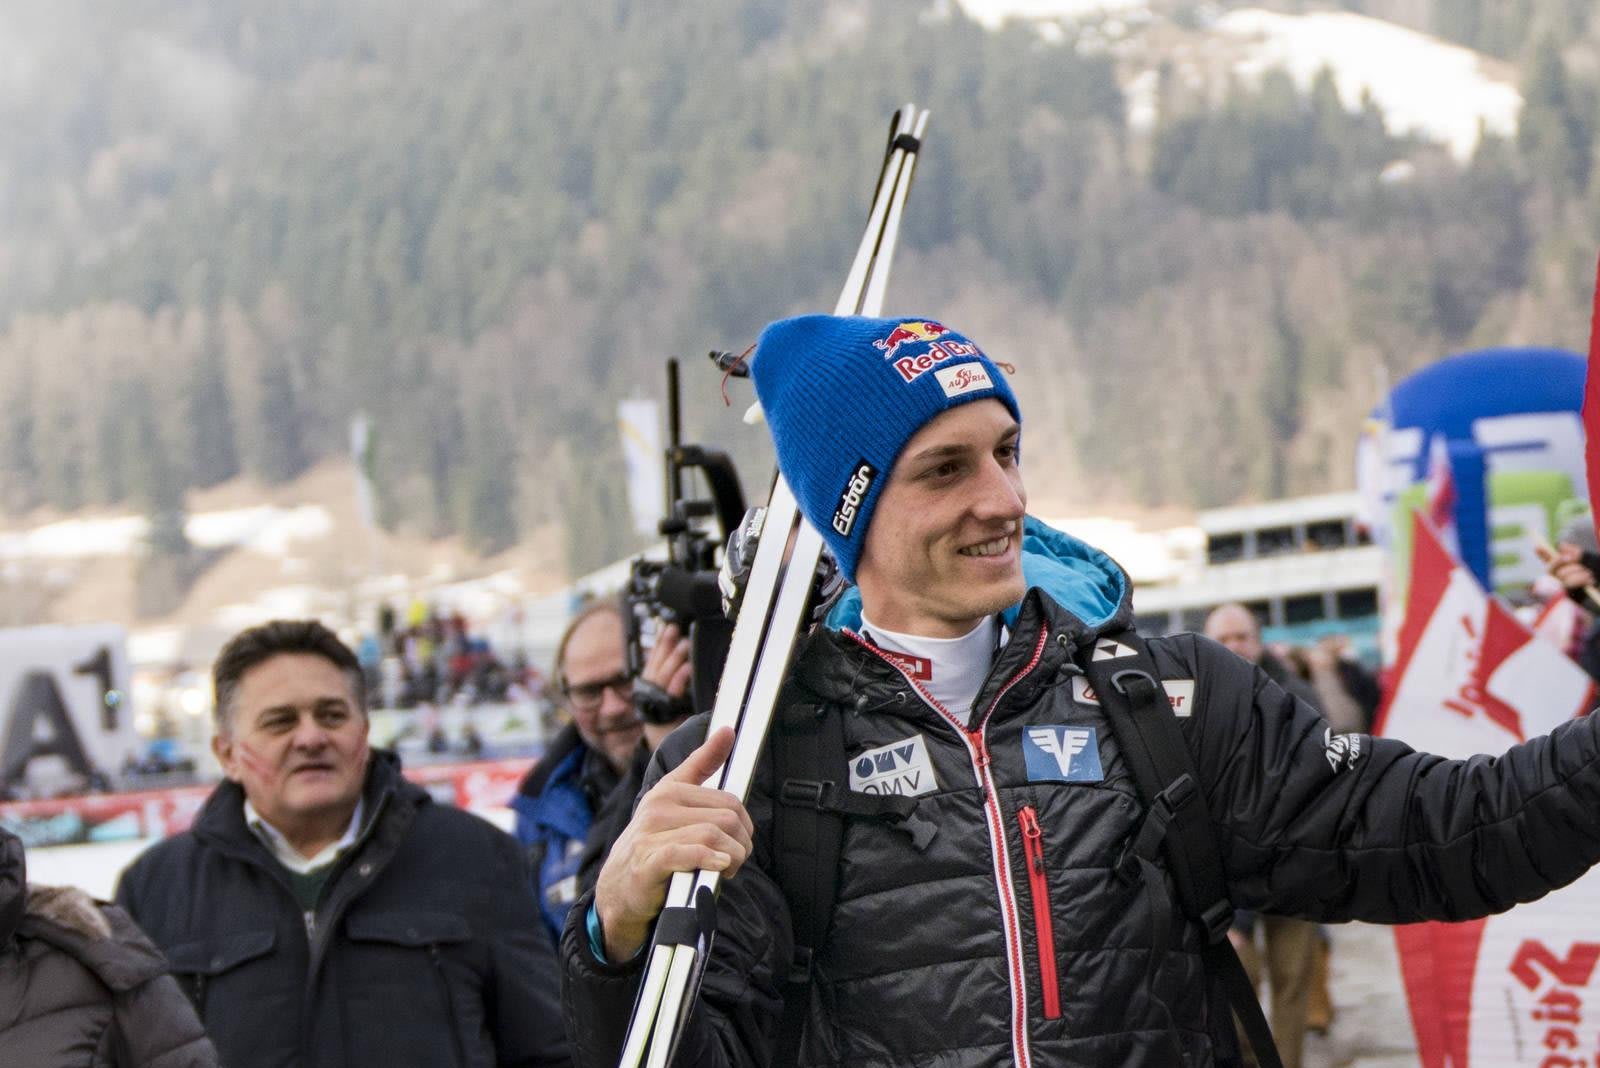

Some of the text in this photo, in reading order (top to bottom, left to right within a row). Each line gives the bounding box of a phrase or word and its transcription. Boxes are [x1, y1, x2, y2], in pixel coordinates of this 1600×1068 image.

[893, 340, 982, 383] Red Bu
[832, 465, 870, 536] Eisbär
[863, 770, 920, 796] OMV
